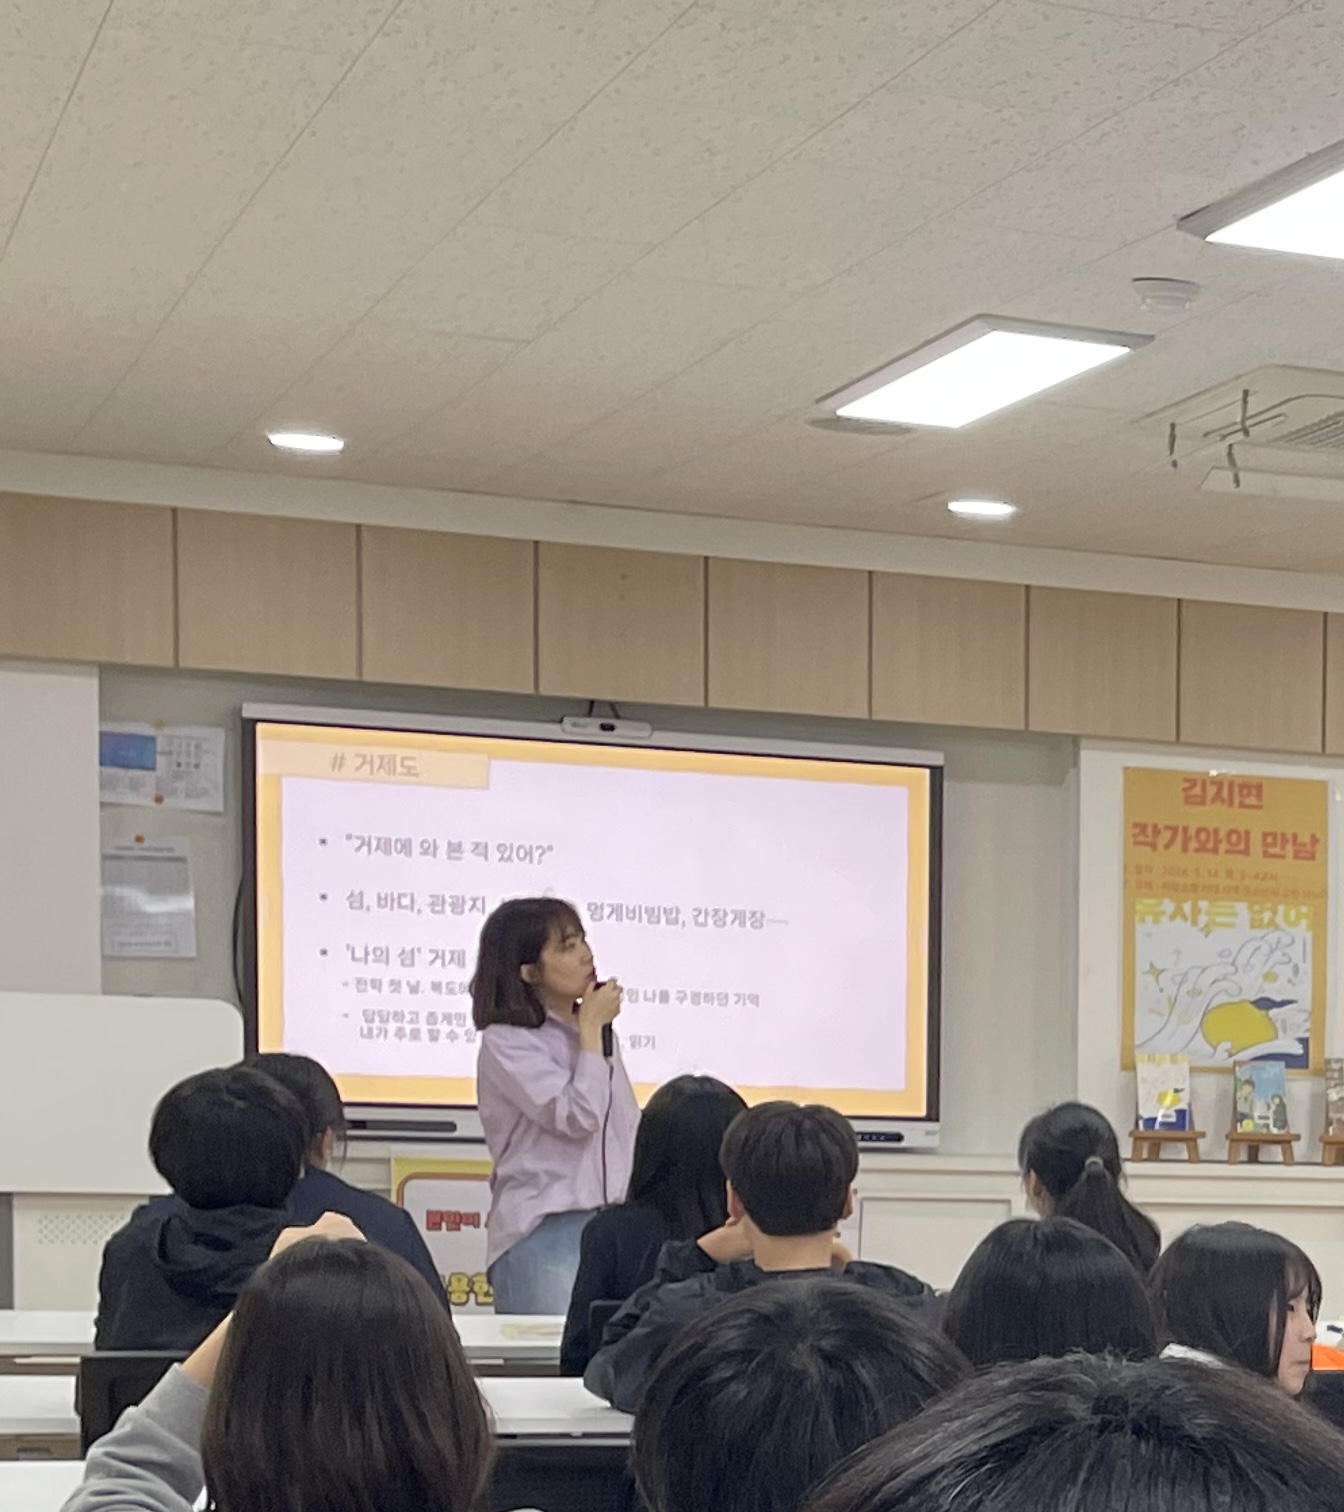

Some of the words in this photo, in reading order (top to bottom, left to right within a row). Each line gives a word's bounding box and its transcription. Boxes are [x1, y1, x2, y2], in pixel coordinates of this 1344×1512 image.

[354, 752, 420, 778] 거제도
[1181, 777, 1264, 810] 김지현
[419, 838, 439, 859] 와
[445, 840, 464, 861] 본
[470, 841, 489, 862] 적
[1132, 821, 1251, 857] 작가와의
[1261, 831, 1320, 861] 만남
